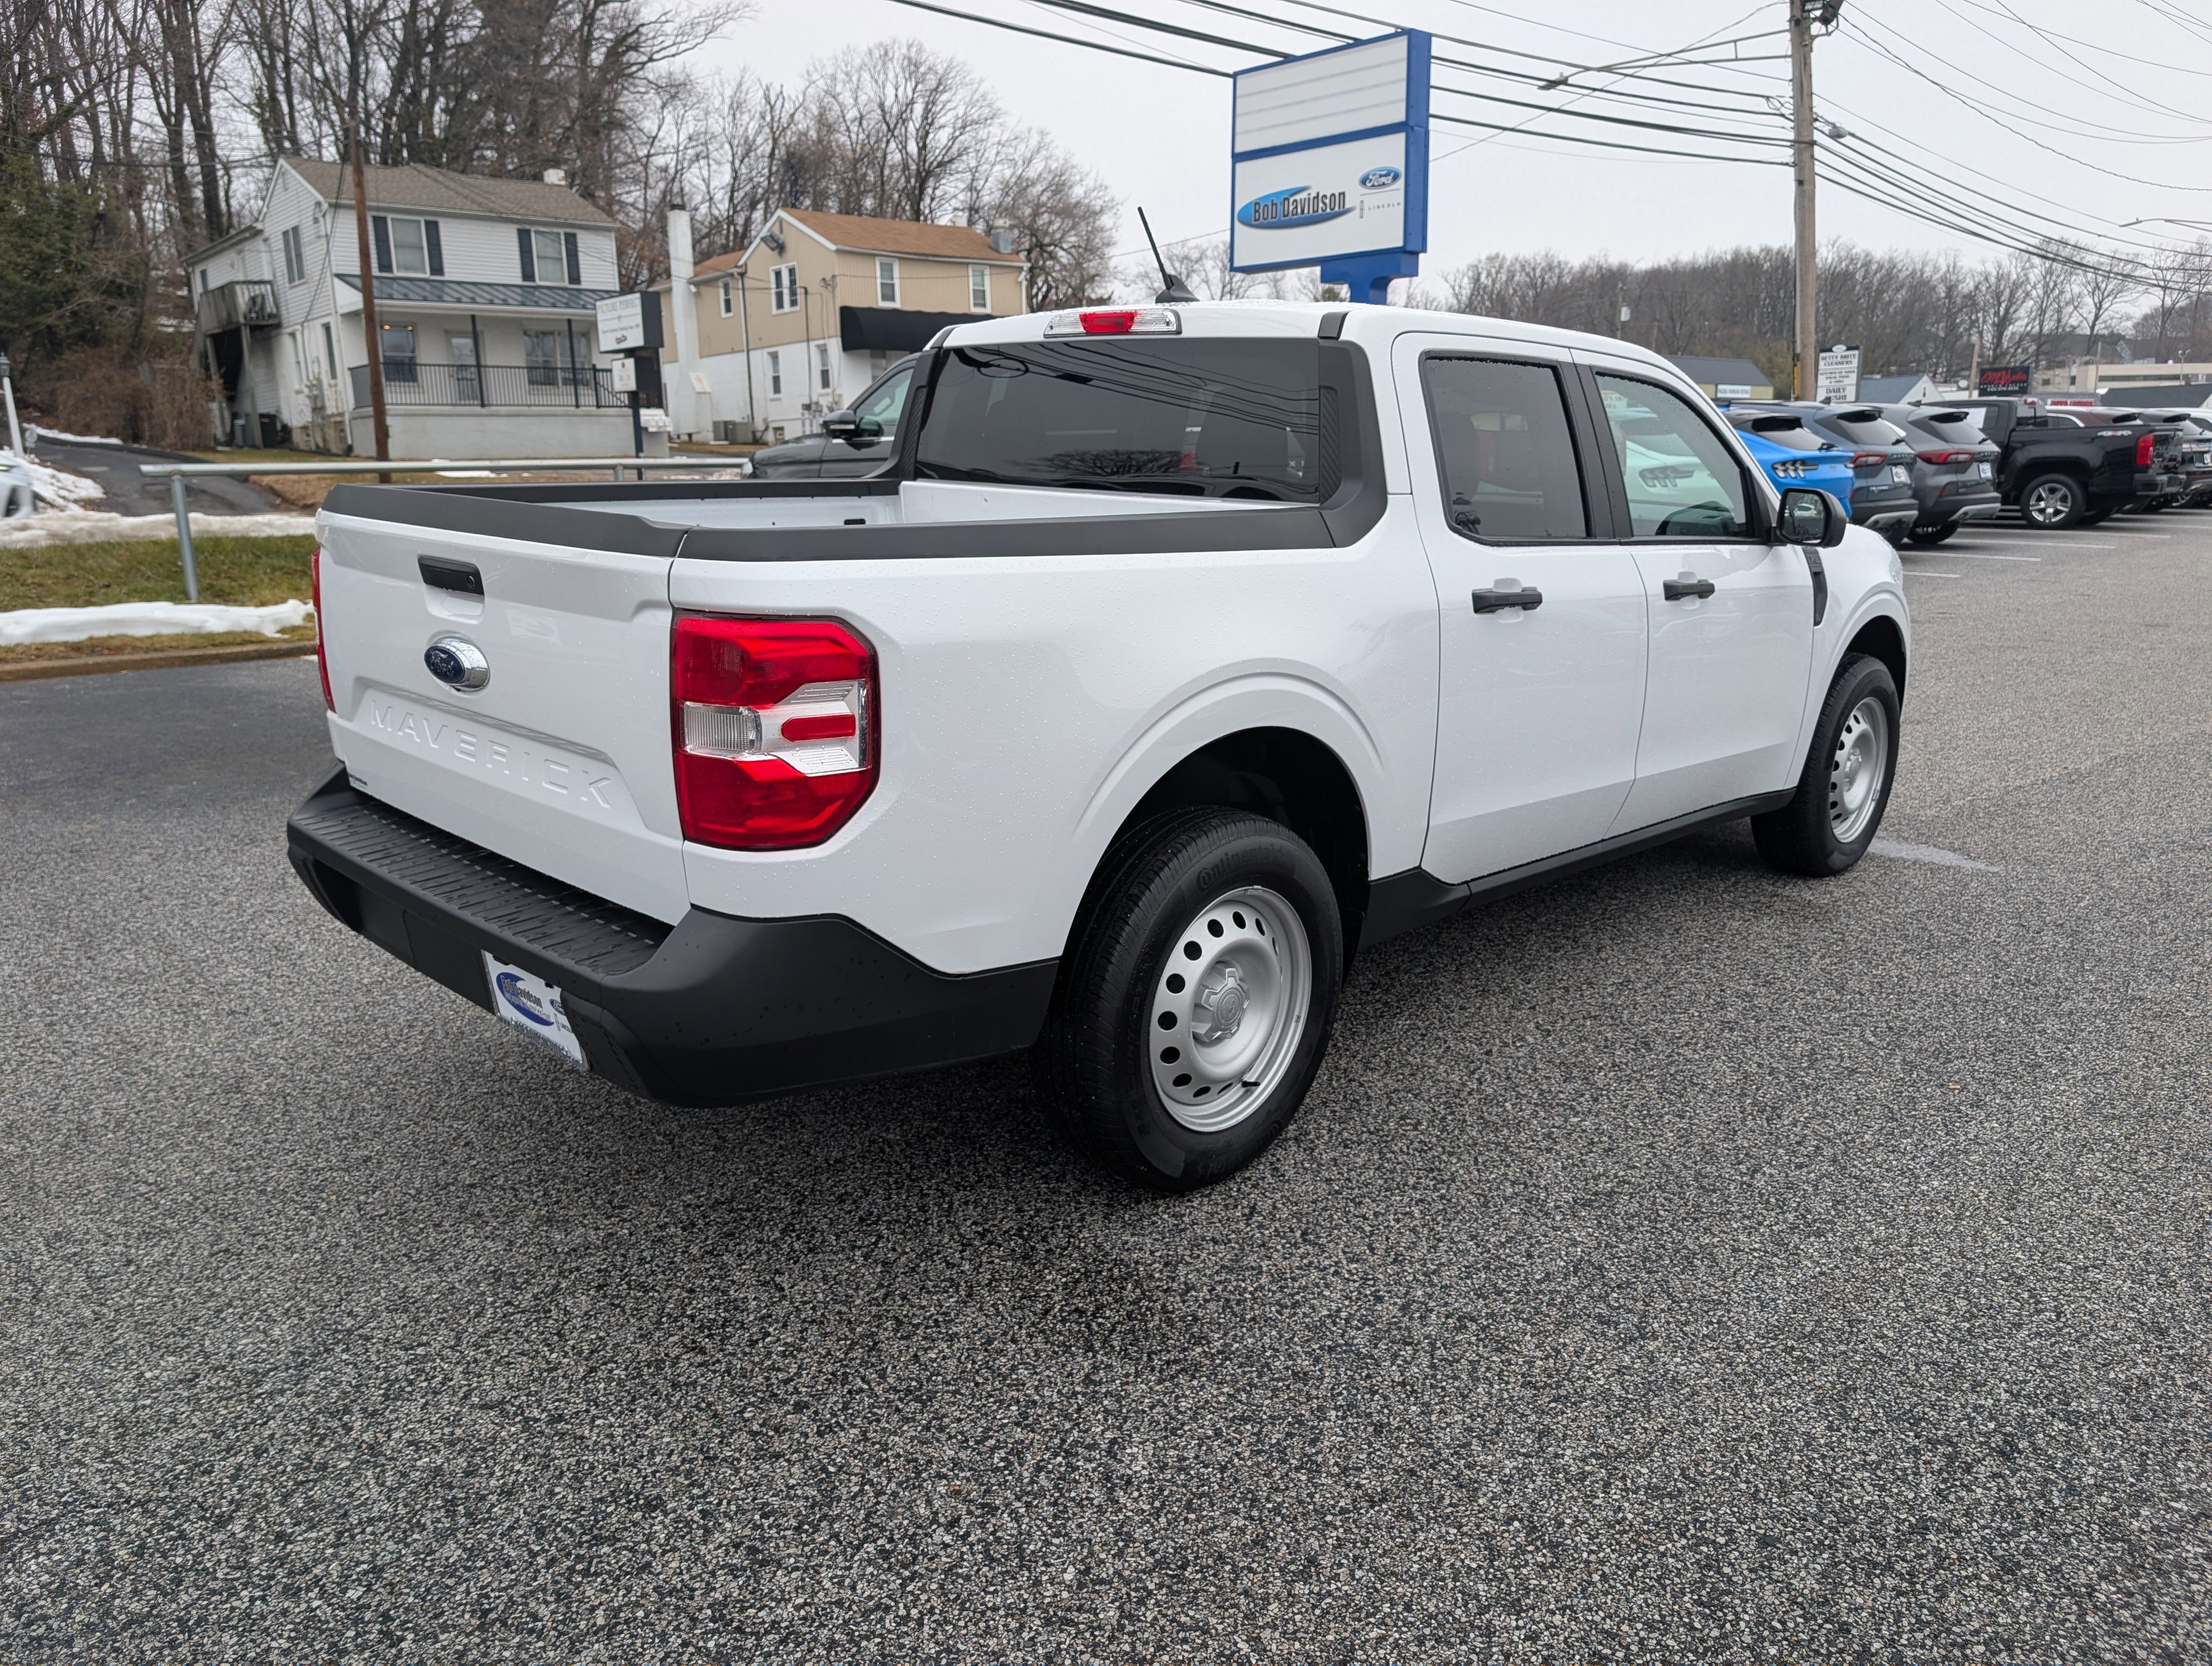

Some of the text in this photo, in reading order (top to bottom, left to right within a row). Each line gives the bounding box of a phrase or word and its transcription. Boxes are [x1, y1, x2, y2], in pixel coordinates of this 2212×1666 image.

[1366, 170, 1395, 186] Ford
[1252, 190, 1347, 223] Bob Davidson
[371, 700, 612, 809] MAVERICK
[512, 982, 543, 1010] Davidson
